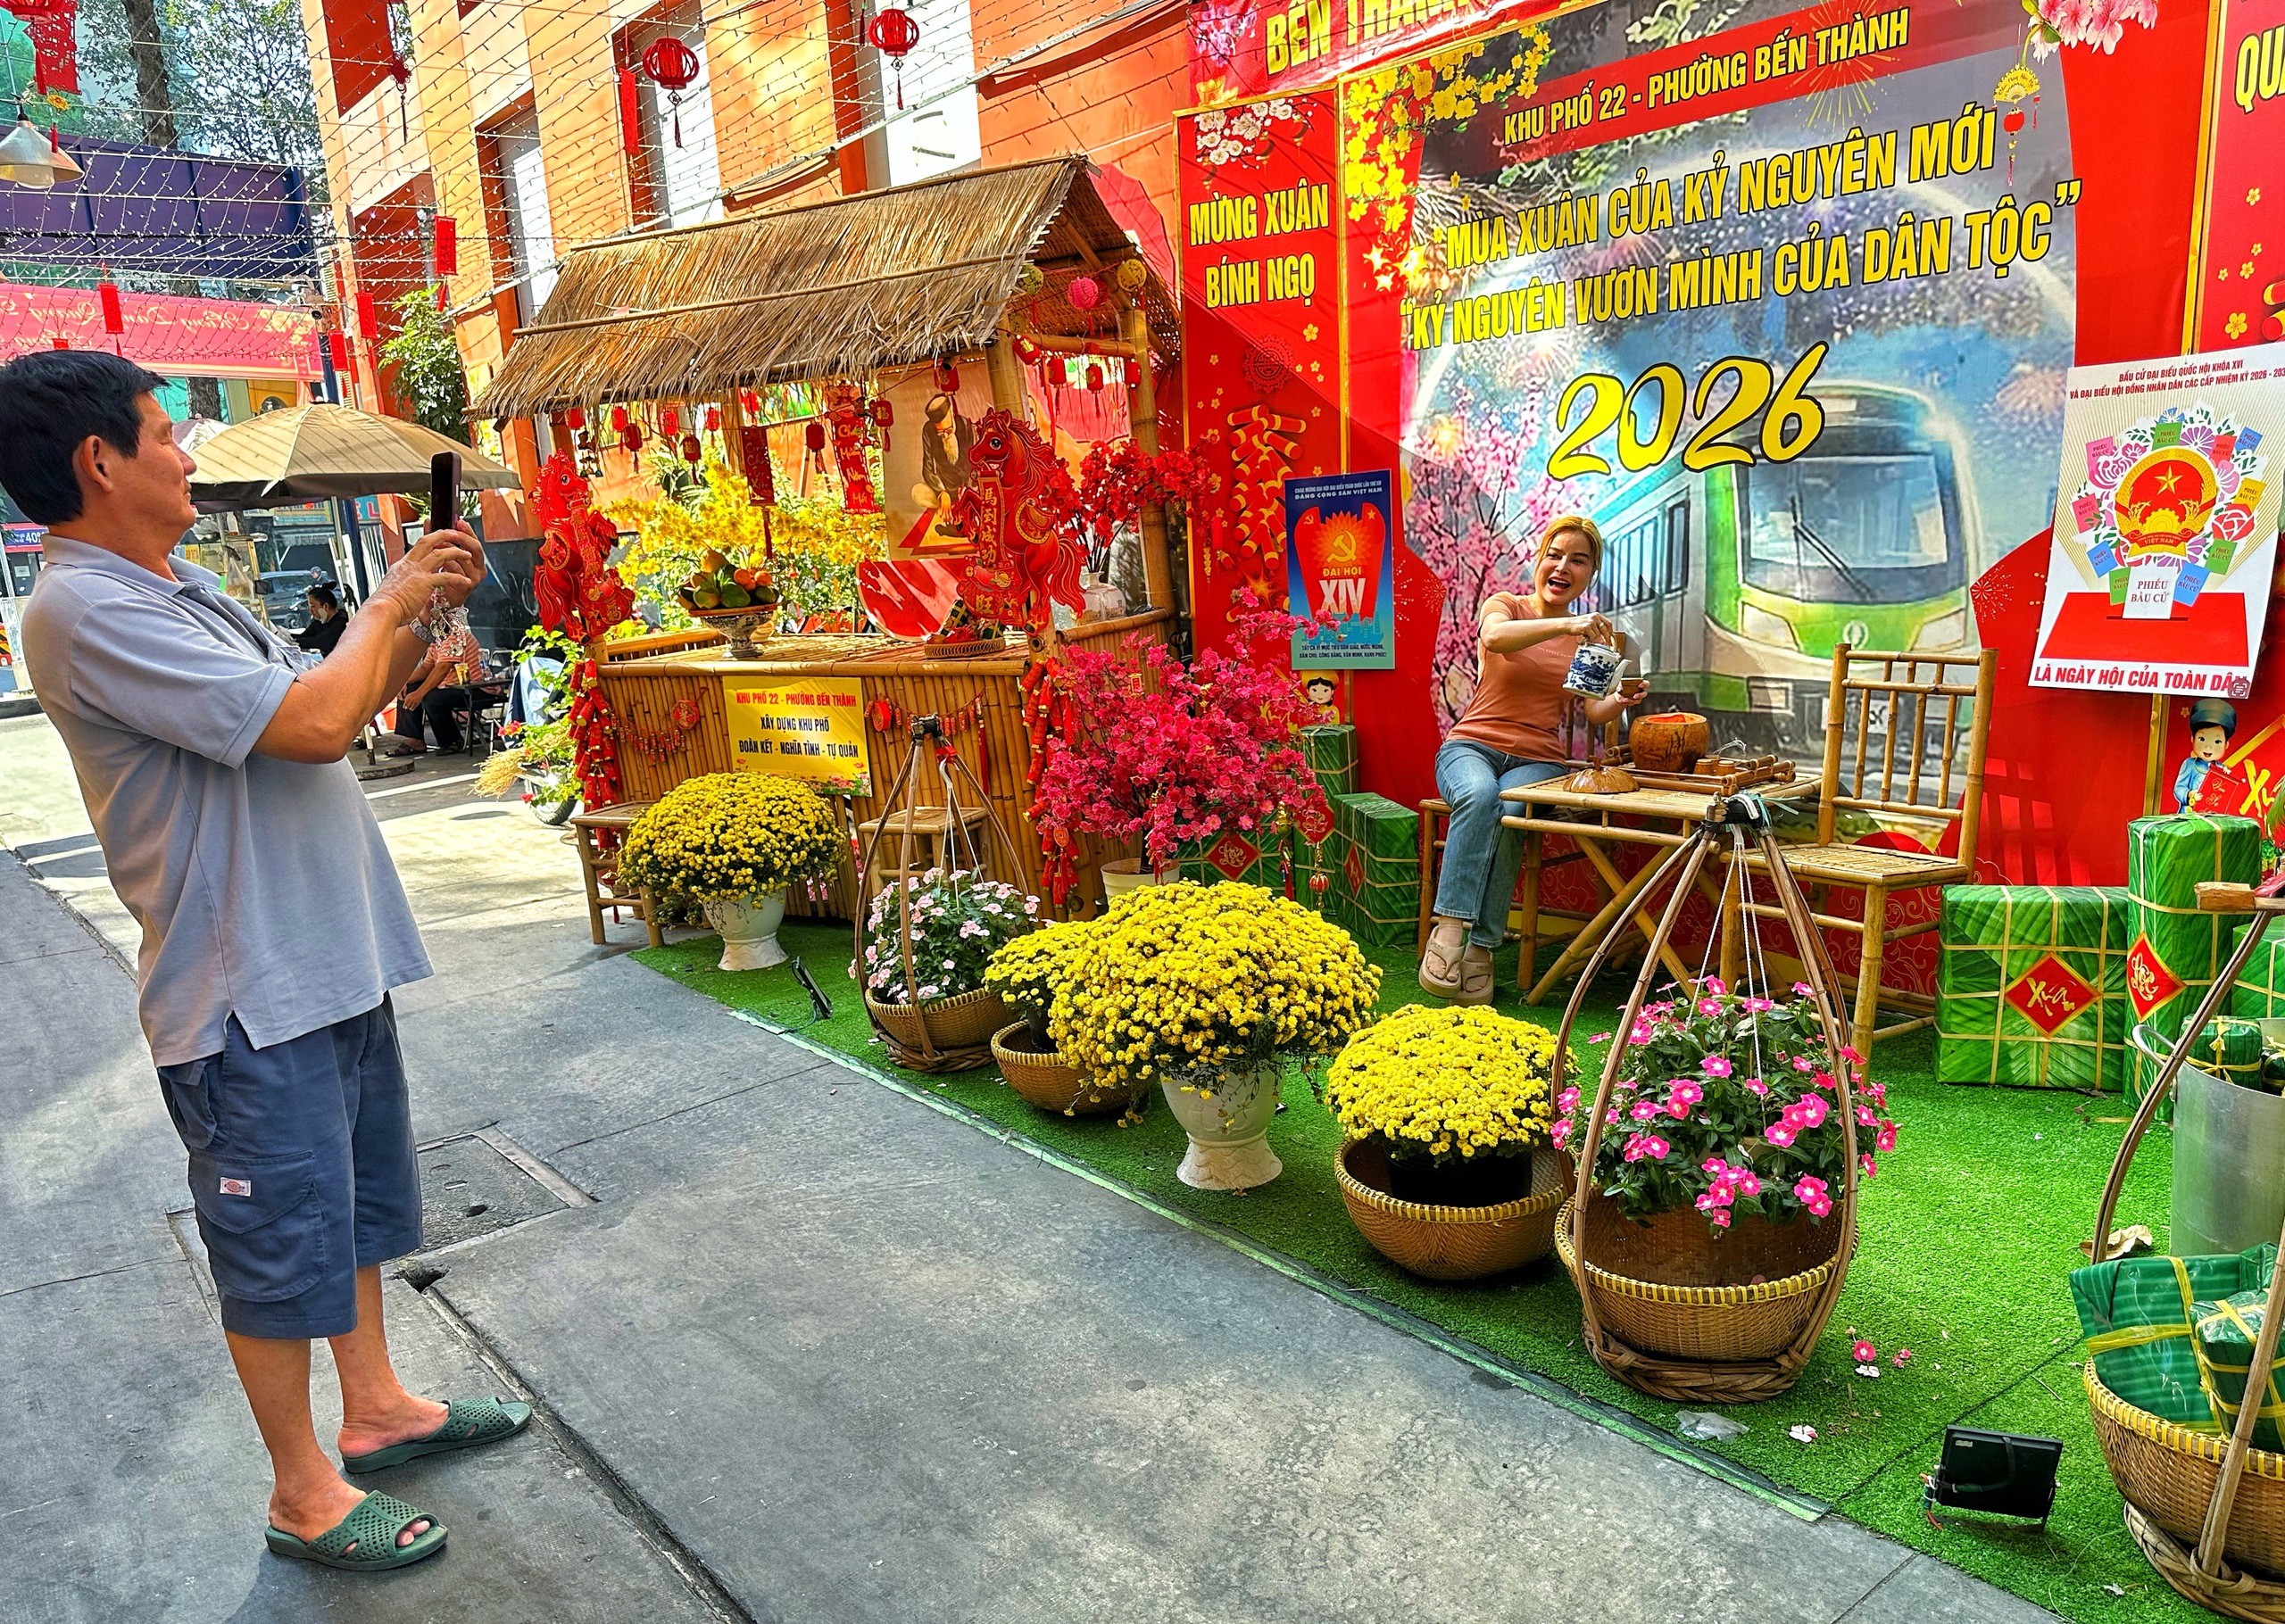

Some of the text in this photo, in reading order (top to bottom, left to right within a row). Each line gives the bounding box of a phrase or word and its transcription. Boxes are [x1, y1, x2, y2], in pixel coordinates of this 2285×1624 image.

[1504, 8, 1910, 145] KHU PHỐ 22 - PHƯỜNG BẾN THÀNH
[1446, 101, 1998, 269] MÙA XUÂN CỦA KỶ NGUYÊN MỚI
[1189, 178, 1329, 246] MỪNG XUÂN
[1205, 253, 1315, 309] BÍNH NGỌ
[1452, 276, 1566, 344] NGUYÊN
[1573, 265, 1659, 326] VƯƠN
[1668, 246, 1764, 313] MÌNH
[1774, 220, 1851, 295] CỦA
[1863, 211, 1952, 285] DÂN
[2070, 389, 2079, 399] VÀ
[2081, 389, 2092, 400] ĐẠI
[2094, 385, 2110, 397] BIỂU
[2112, 385, 2124, 397] HỘI
[2184, 377, 2198, 389] CÁC
[2200, 374, 2214, 387] CẤP
[2215, 373, 2238, 385] NHIỆM
[2250, 369, 2267, 381] 2026
[2147, 369, 2159, 381] ĐẠI
[2161, 365, 2178, 378] BIỂU
[2179, 363, 2198, 377] QUỐC
[2198, 363, 2211, 375] HỘI
[2212, 360, 2231, 372] KHÓA
[2231, 360, 2244, 369] XVI
[1546, 340, 1830, 483] 2026
[1322, 566, 1362, 578] ĐẠI HỘI
[2137, 577, 2168, 590] PHIẾU
[976, 594, 993, 615] 旺
[1319, 578, 1366, 614] XIV
[2131, 591, 2169, 602] BẦU CỬ
[2033, 663, 2051, 682] LÀ
[2055, 665, 2097, 684] NGÀY
[2098, 666, 2123, 689] HỘI
[2127, 664, 2158, 688] CỦA
[2164, 669, 2207, 691] TOÀN
[735, 692, 751, 704] KHU
[752, 690, 767, 704] PHỐ
[769, 692, 779, 705] 22
[785, 690, 814, 707] PHƯỜNG
[817, 690, 830, 707] BẾN
[832, 692, 856, 708] THÀNH
[760, 714, 830, 733] XÂY DỰNG KHU PHỐ
[739, 737, 759, 754] ĐOÀN
[760, 737, 773, 754] KẾT
[780, 740, 802, 756] NGHĨA
[803, 740, 820, 757] TÌNH
[827, 742, 837, 762] TỰ
[838, 740, 859, 758] QUẢN
